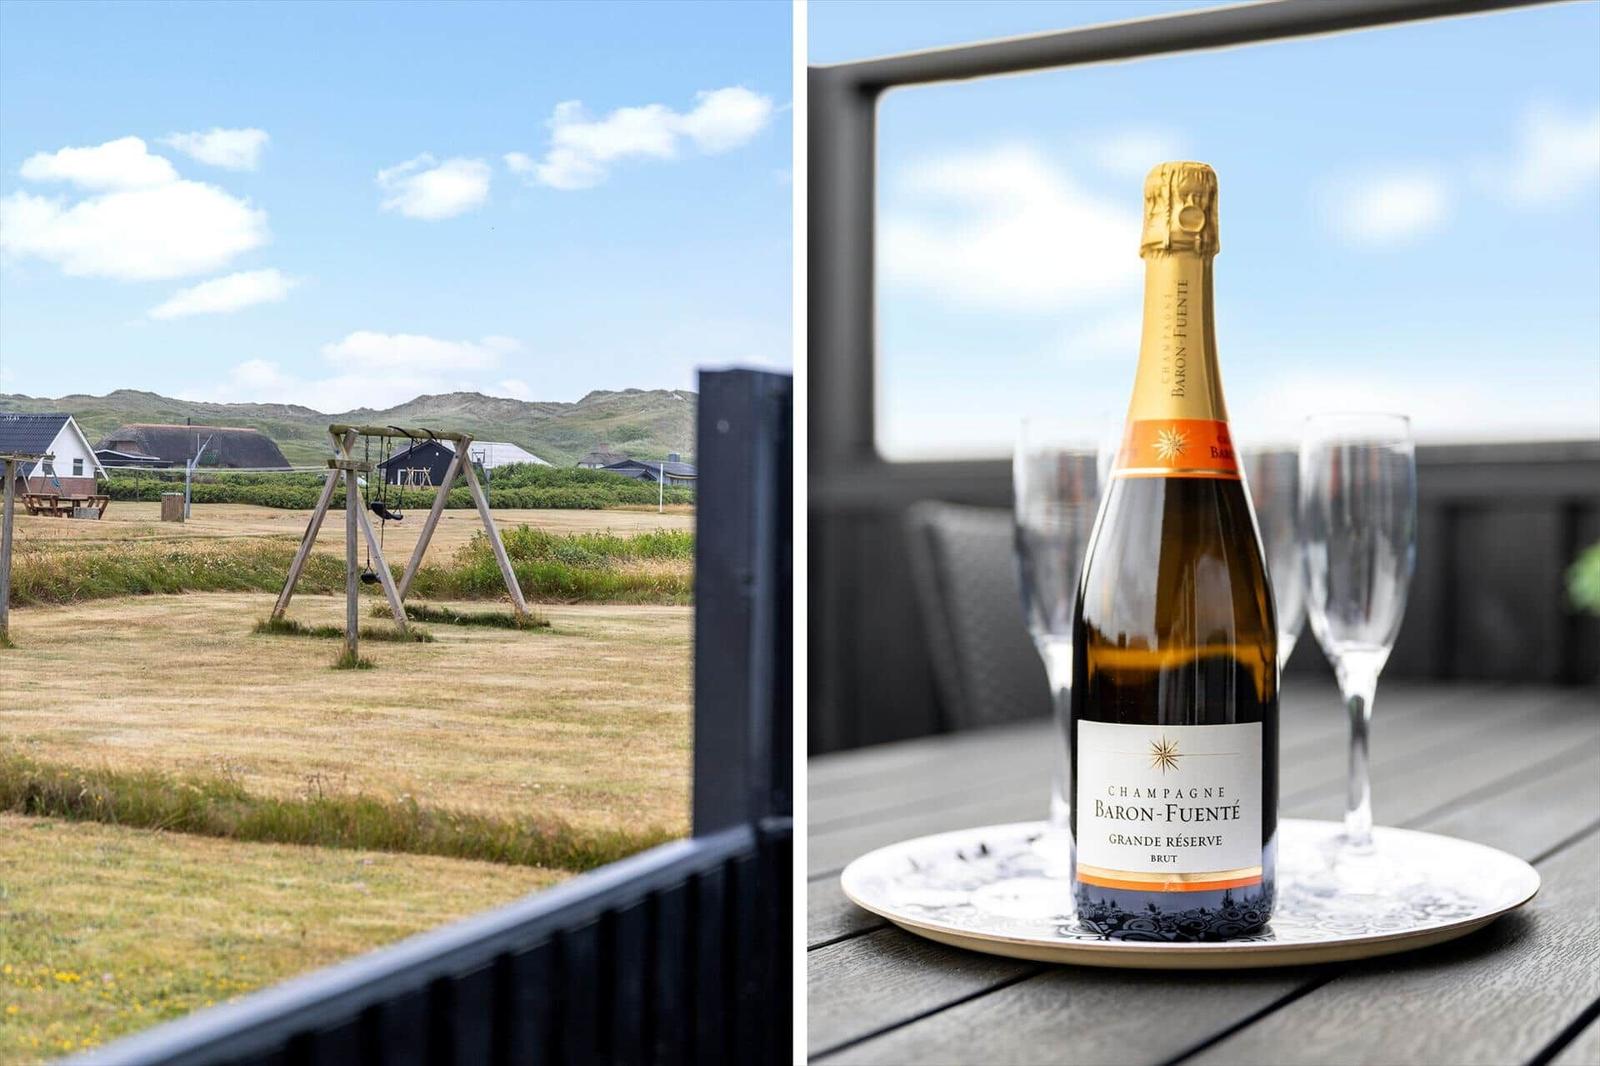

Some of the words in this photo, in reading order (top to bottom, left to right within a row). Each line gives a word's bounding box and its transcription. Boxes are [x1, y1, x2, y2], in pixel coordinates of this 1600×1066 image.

[1108, 786, 1225, 798] CHAMPAGNE
[1095, 799, 1240, 822] BARON-FUENTÉ
[1108, 834, 1162, 847] GRANDE
[1166, 833, 1223, 848] RÉSERVE
[1150, 854, 1178, 863] BRUT
